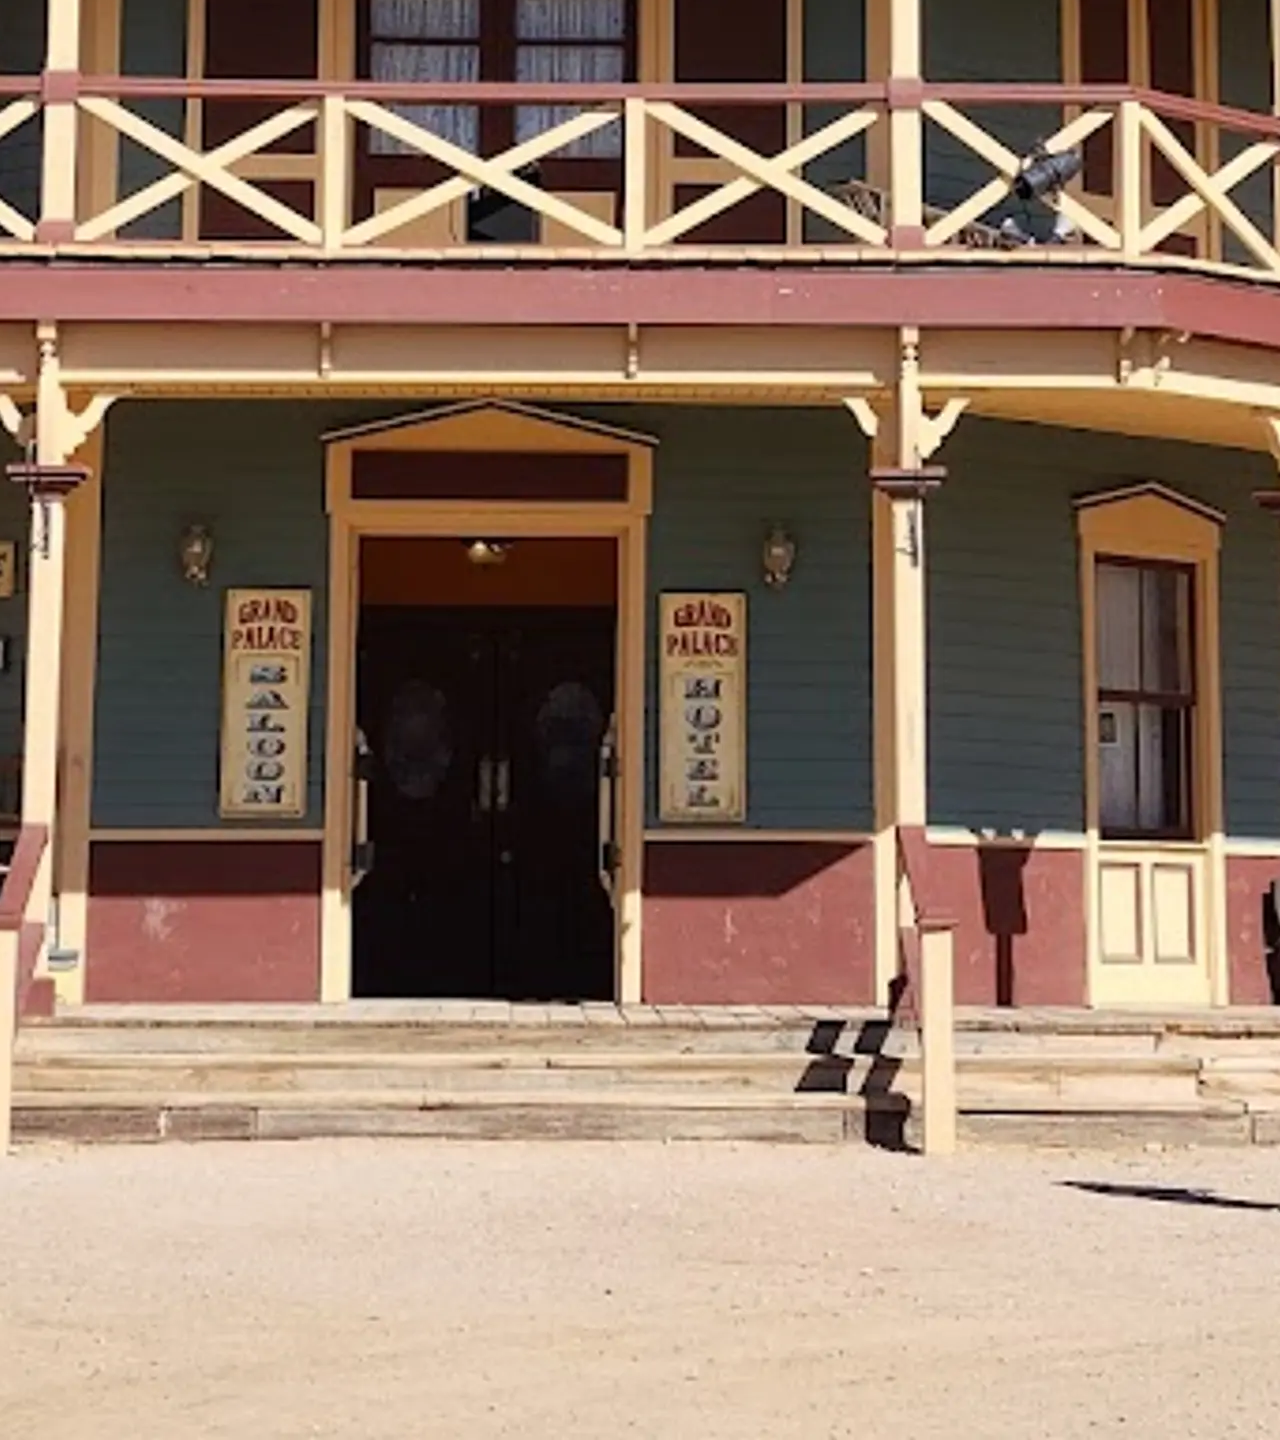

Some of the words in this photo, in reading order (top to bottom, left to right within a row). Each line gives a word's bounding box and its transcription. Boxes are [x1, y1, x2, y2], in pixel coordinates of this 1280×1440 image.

[238, 598, 298, 625] GRAND
[673, 600, 732, 630] GRAND
[231, 625, 303, 651] PALACE
[665, 631, 739, 657] PALACE
